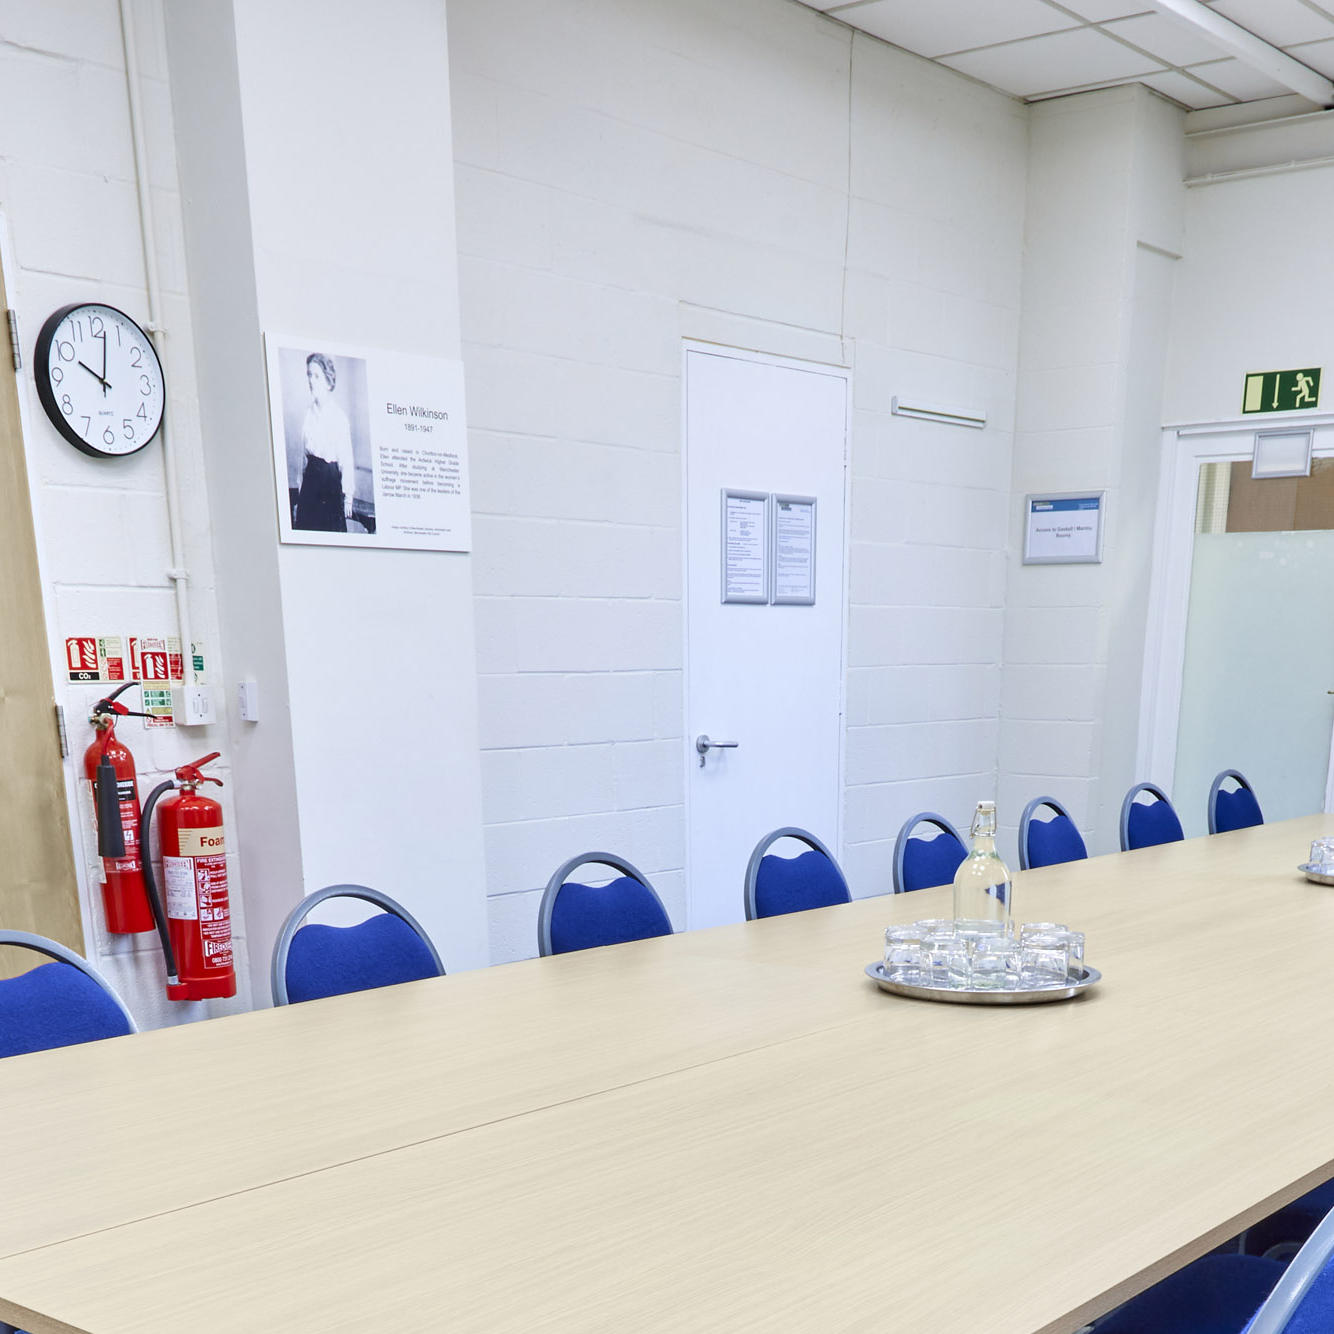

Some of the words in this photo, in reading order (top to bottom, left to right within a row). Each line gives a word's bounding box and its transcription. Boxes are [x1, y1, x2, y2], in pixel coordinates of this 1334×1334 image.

[70, 320, 83, 342] 11
[88, 316, 106, 338] 12
[116, 325, 121, 347] 1
[55, 340, 75, 362] 10
[130, 346, 142, 368] 2
[51, 367, 64, 387] 9
[140, 374, 152, 396] 3
[62, 394, 74, 415] 8
[136, 402, 148, 422] 4
[387, 402, 407, 416] Ellen
[409, 406, 448, 420] Wilkinson
[80, 416, 91, 437] 7
[103, 425, 114, 445] 6
[123, 418, 134, 440] 5
[404, 424, 433, 432] 1891-1947
